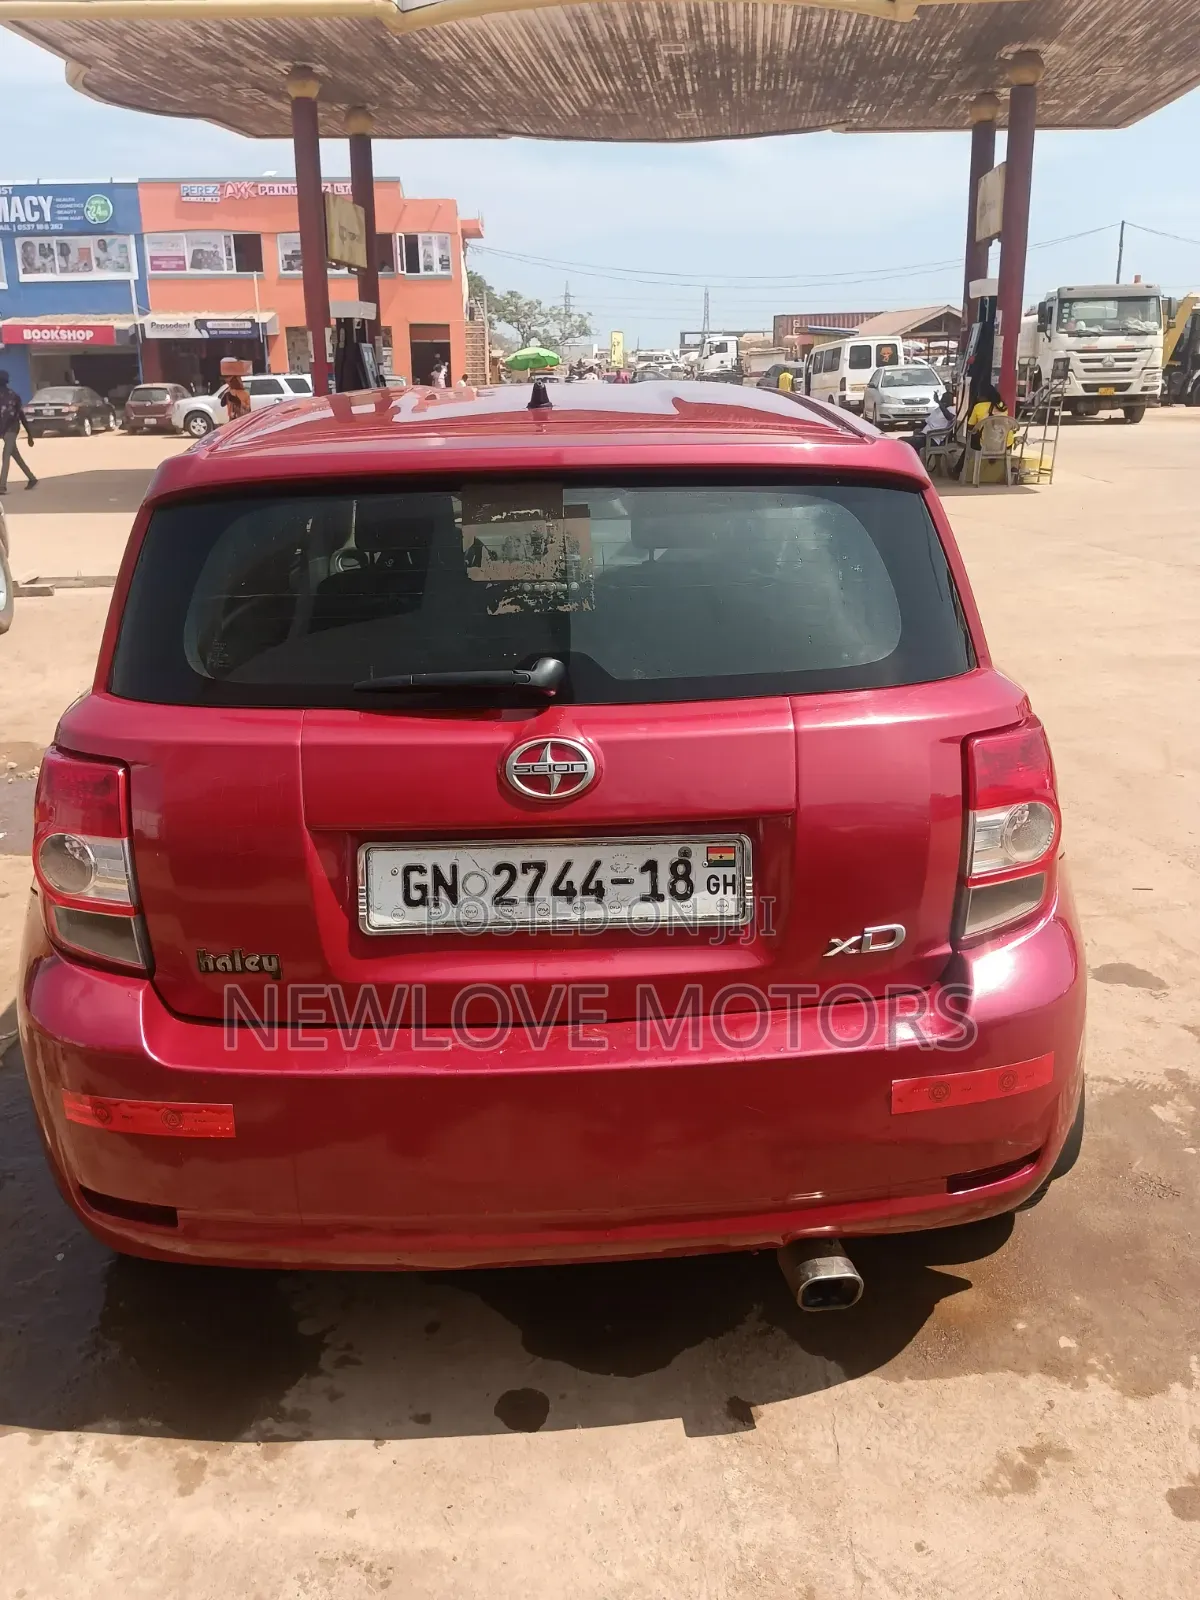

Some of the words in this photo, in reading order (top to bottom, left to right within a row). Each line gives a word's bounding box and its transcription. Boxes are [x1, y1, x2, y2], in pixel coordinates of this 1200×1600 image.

[182, 186, 218, 195] PEREZ
[0, 195, 53, 223] MACY
[150, 321, 190, 330] Pepsodent
[23, 328, 94, 340] BOOKSHOP
[513, 763, 588, 773] SCION
[402, 862, 459, 907] GN
[706, 874, 737, 895] GH
